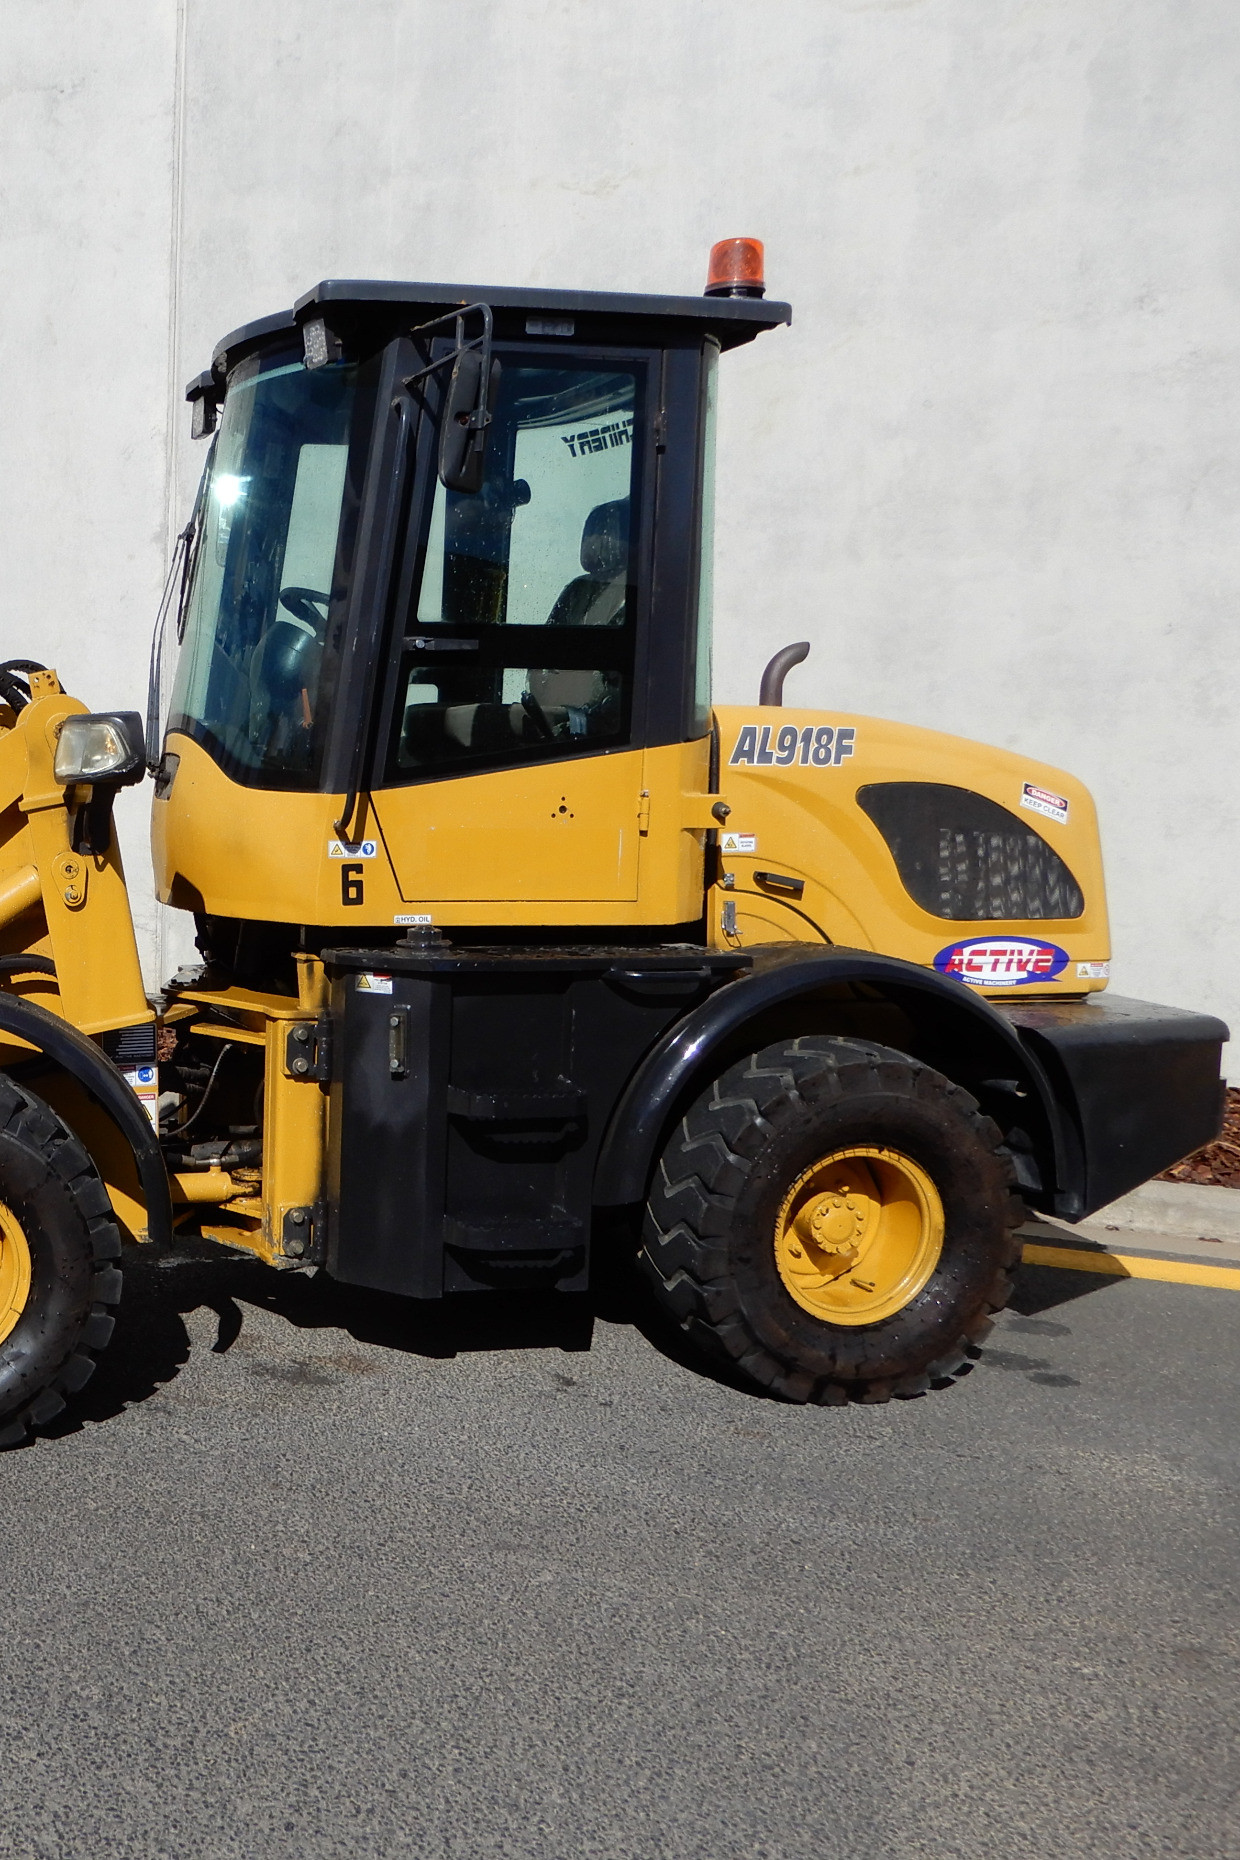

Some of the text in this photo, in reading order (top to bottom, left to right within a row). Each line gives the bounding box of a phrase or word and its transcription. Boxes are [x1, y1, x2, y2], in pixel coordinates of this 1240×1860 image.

[728, 725, 856, 767] AL918F
[1024, 797, 1065, 818] KEEP CLEAR
[341, 863, 364, 906] 6
[944, 949, 1055, 973] ACTIVE
[962, 976, 983, 985] ACTIVE
